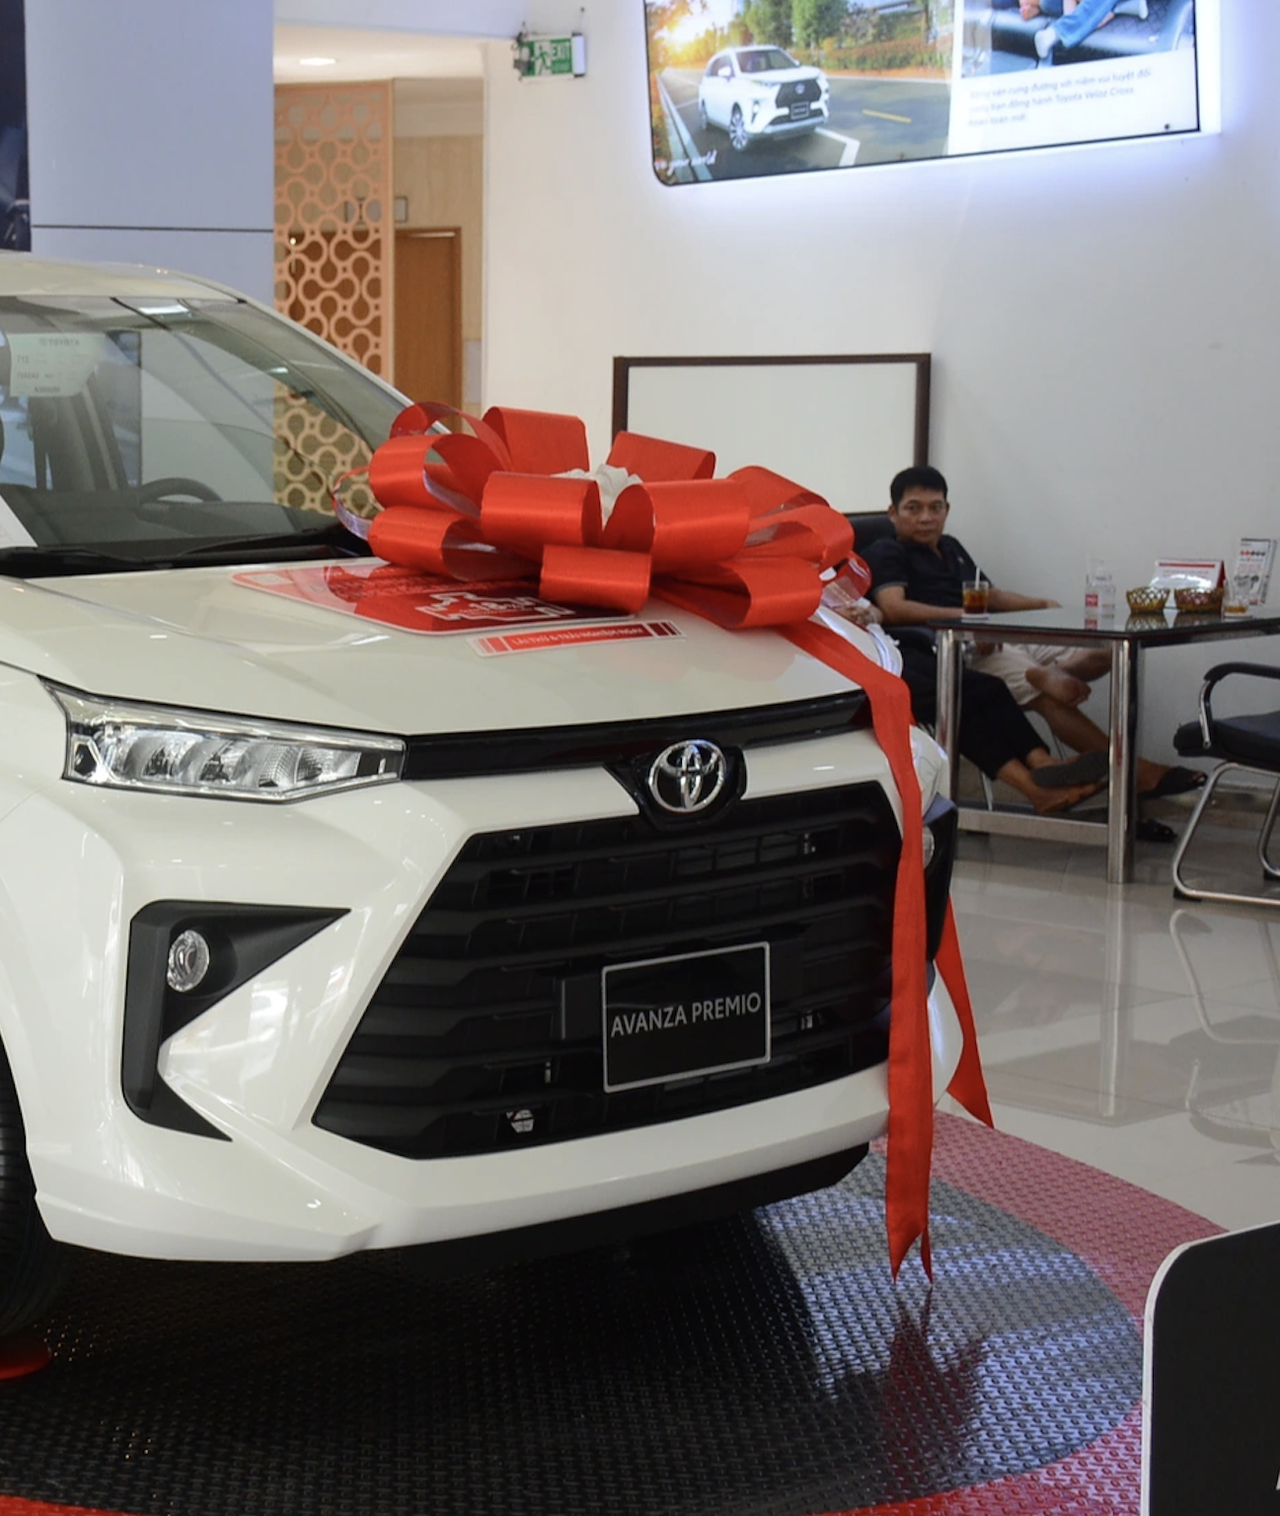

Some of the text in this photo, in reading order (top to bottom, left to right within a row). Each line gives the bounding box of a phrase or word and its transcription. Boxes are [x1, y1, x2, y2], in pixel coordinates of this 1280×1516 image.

[1056, 92, 1083, 103] Toyota
[1085, 89, 1108, 99] Veloz
[1109, 86, 1134, 97] Cross
[48, 339, 80, 347] TOYOTA
[610, 992, 761, 1038] AVANZA PREMIO
